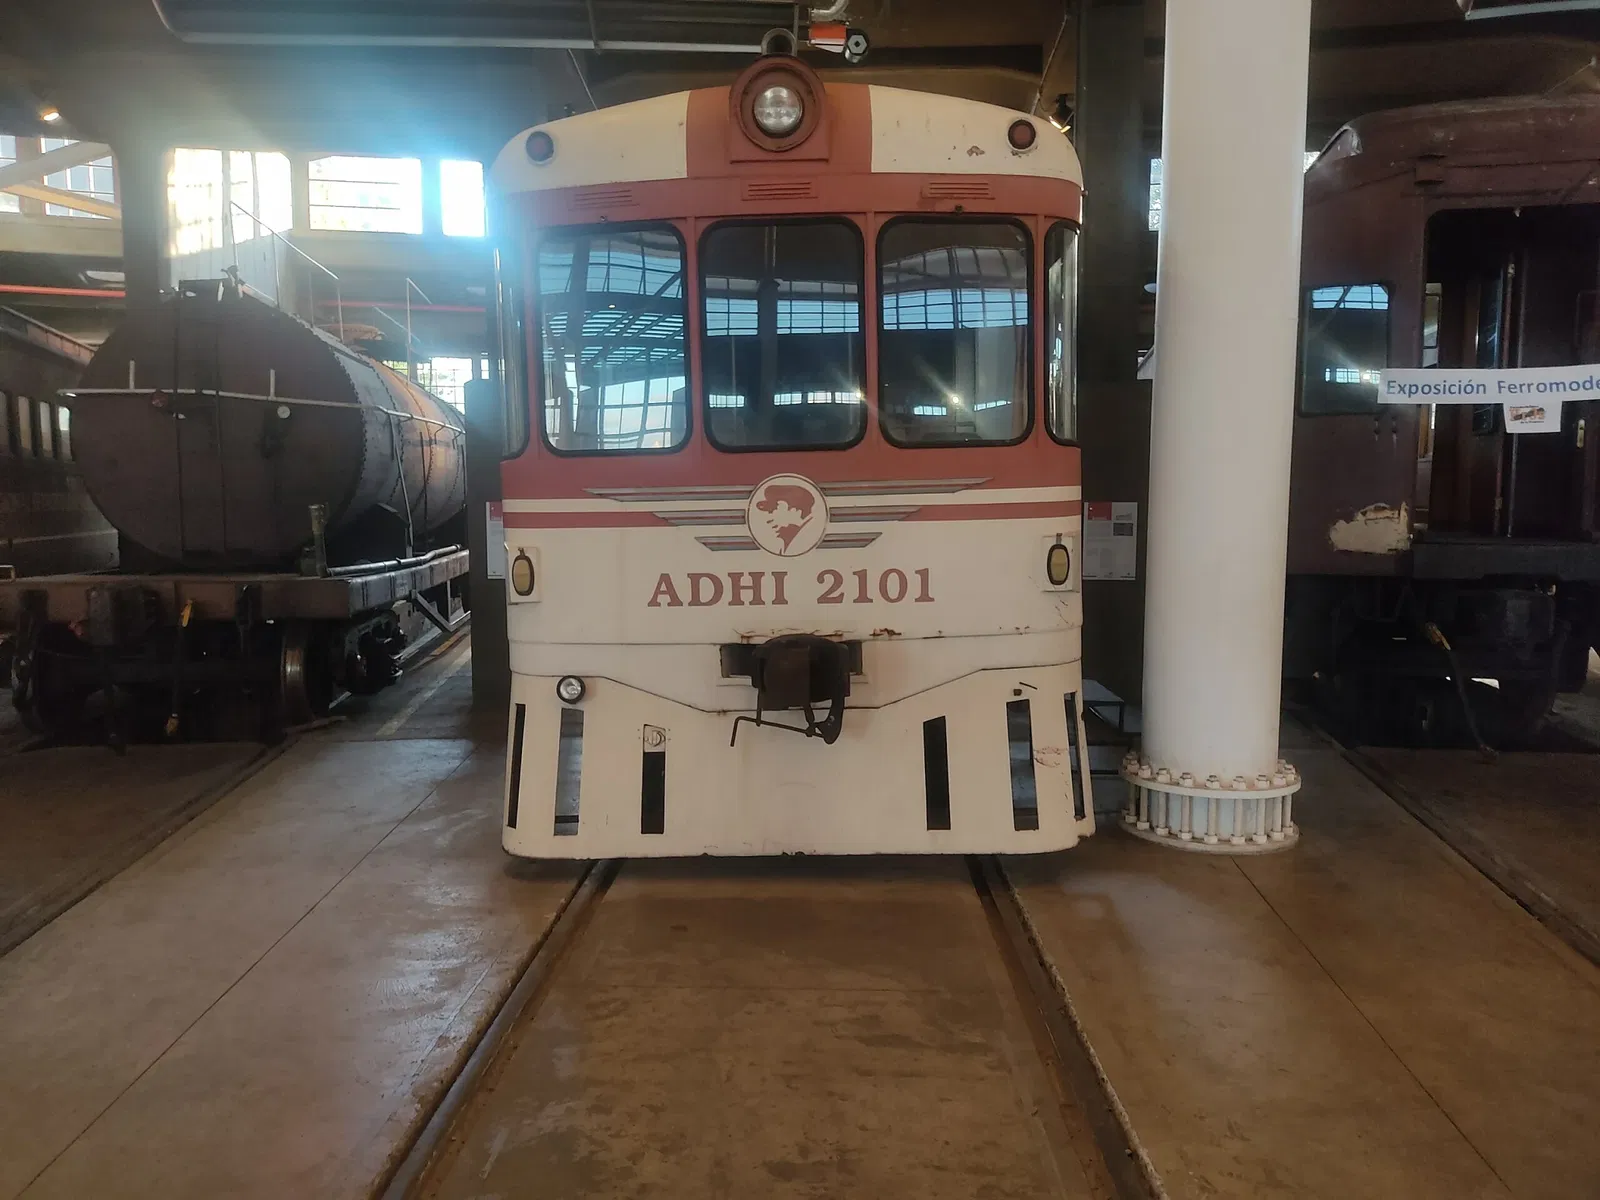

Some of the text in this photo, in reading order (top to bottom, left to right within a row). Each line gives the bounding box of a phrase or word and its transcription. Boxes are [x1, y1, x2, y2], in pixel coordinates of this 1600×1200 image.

[1386, 379, 1487, 398] Exposición
[647, 568, 935, 607] ADHI 2101
